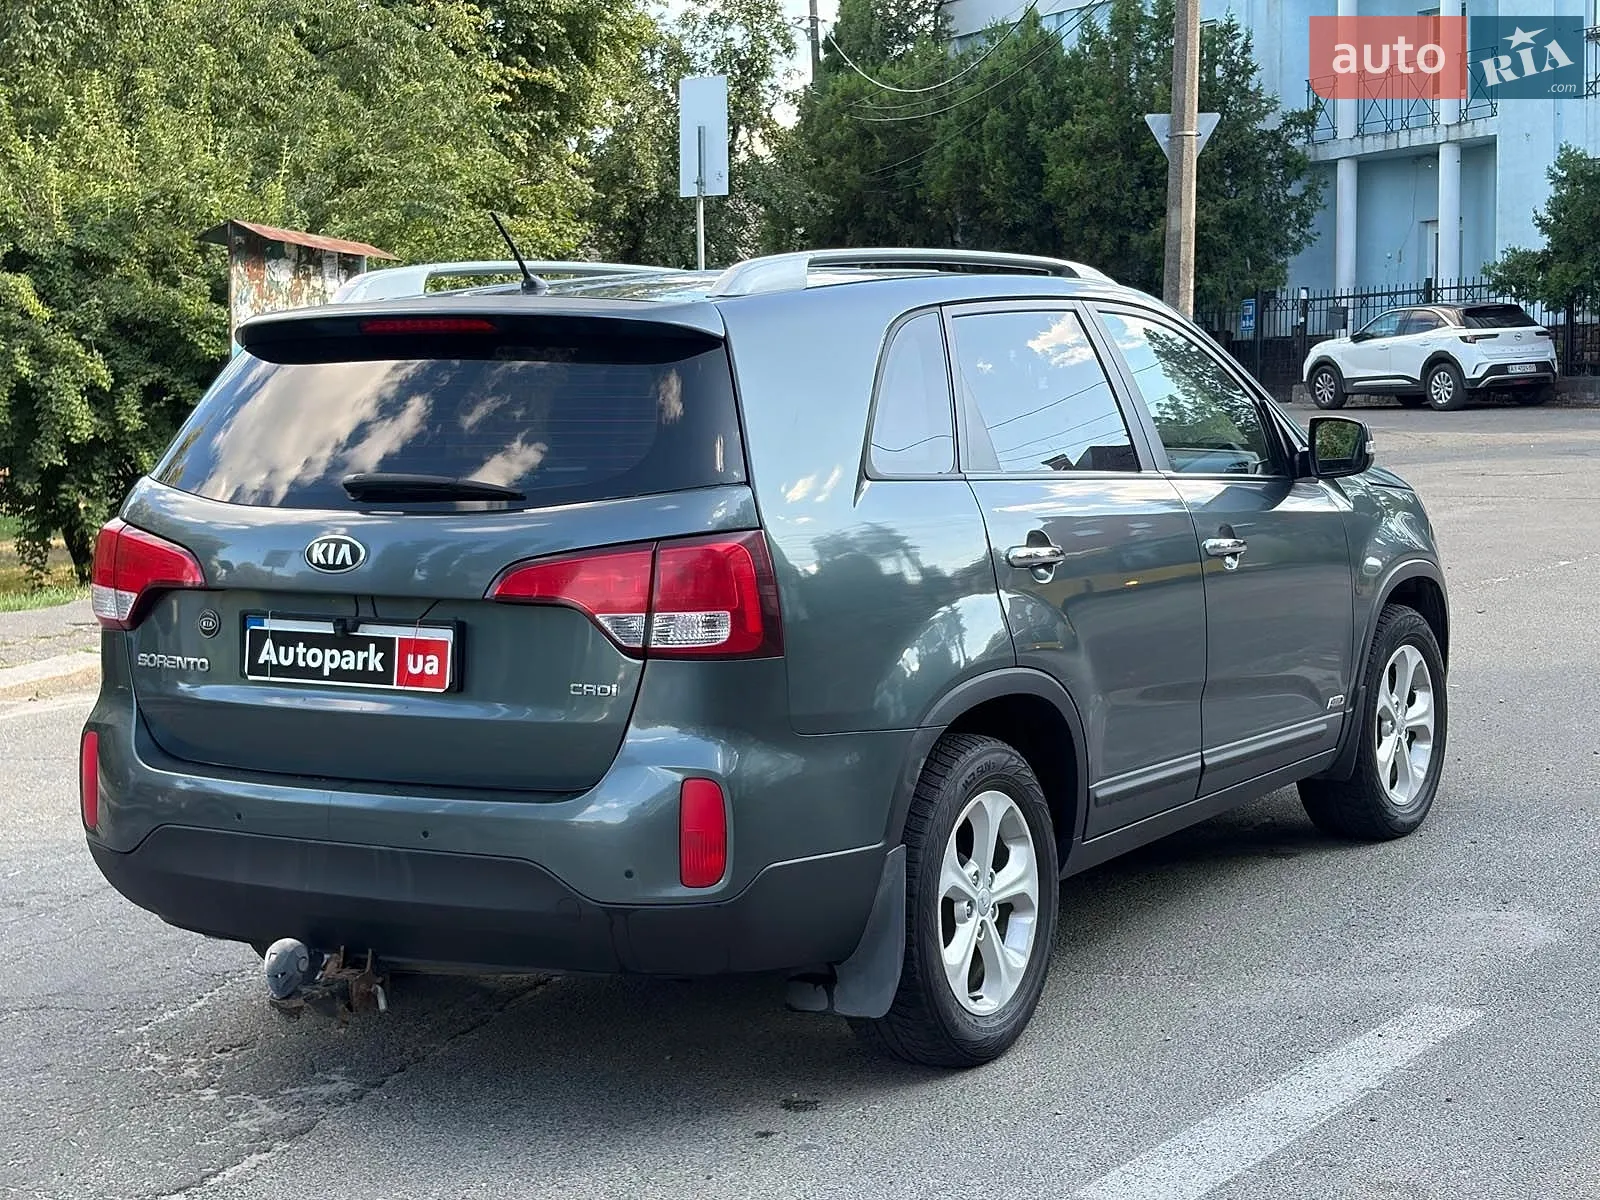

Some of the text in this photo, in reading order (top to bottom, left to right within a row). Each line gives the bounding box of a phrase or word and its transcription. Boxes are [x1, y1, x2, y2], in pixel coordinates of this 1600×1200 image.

[312, 542, 353, 566] KIA
[137, 653, 209, 672] SORENTO
[257, 637, 439, 677] Autopark ua
[569, 683, 617, 697] CRDi
